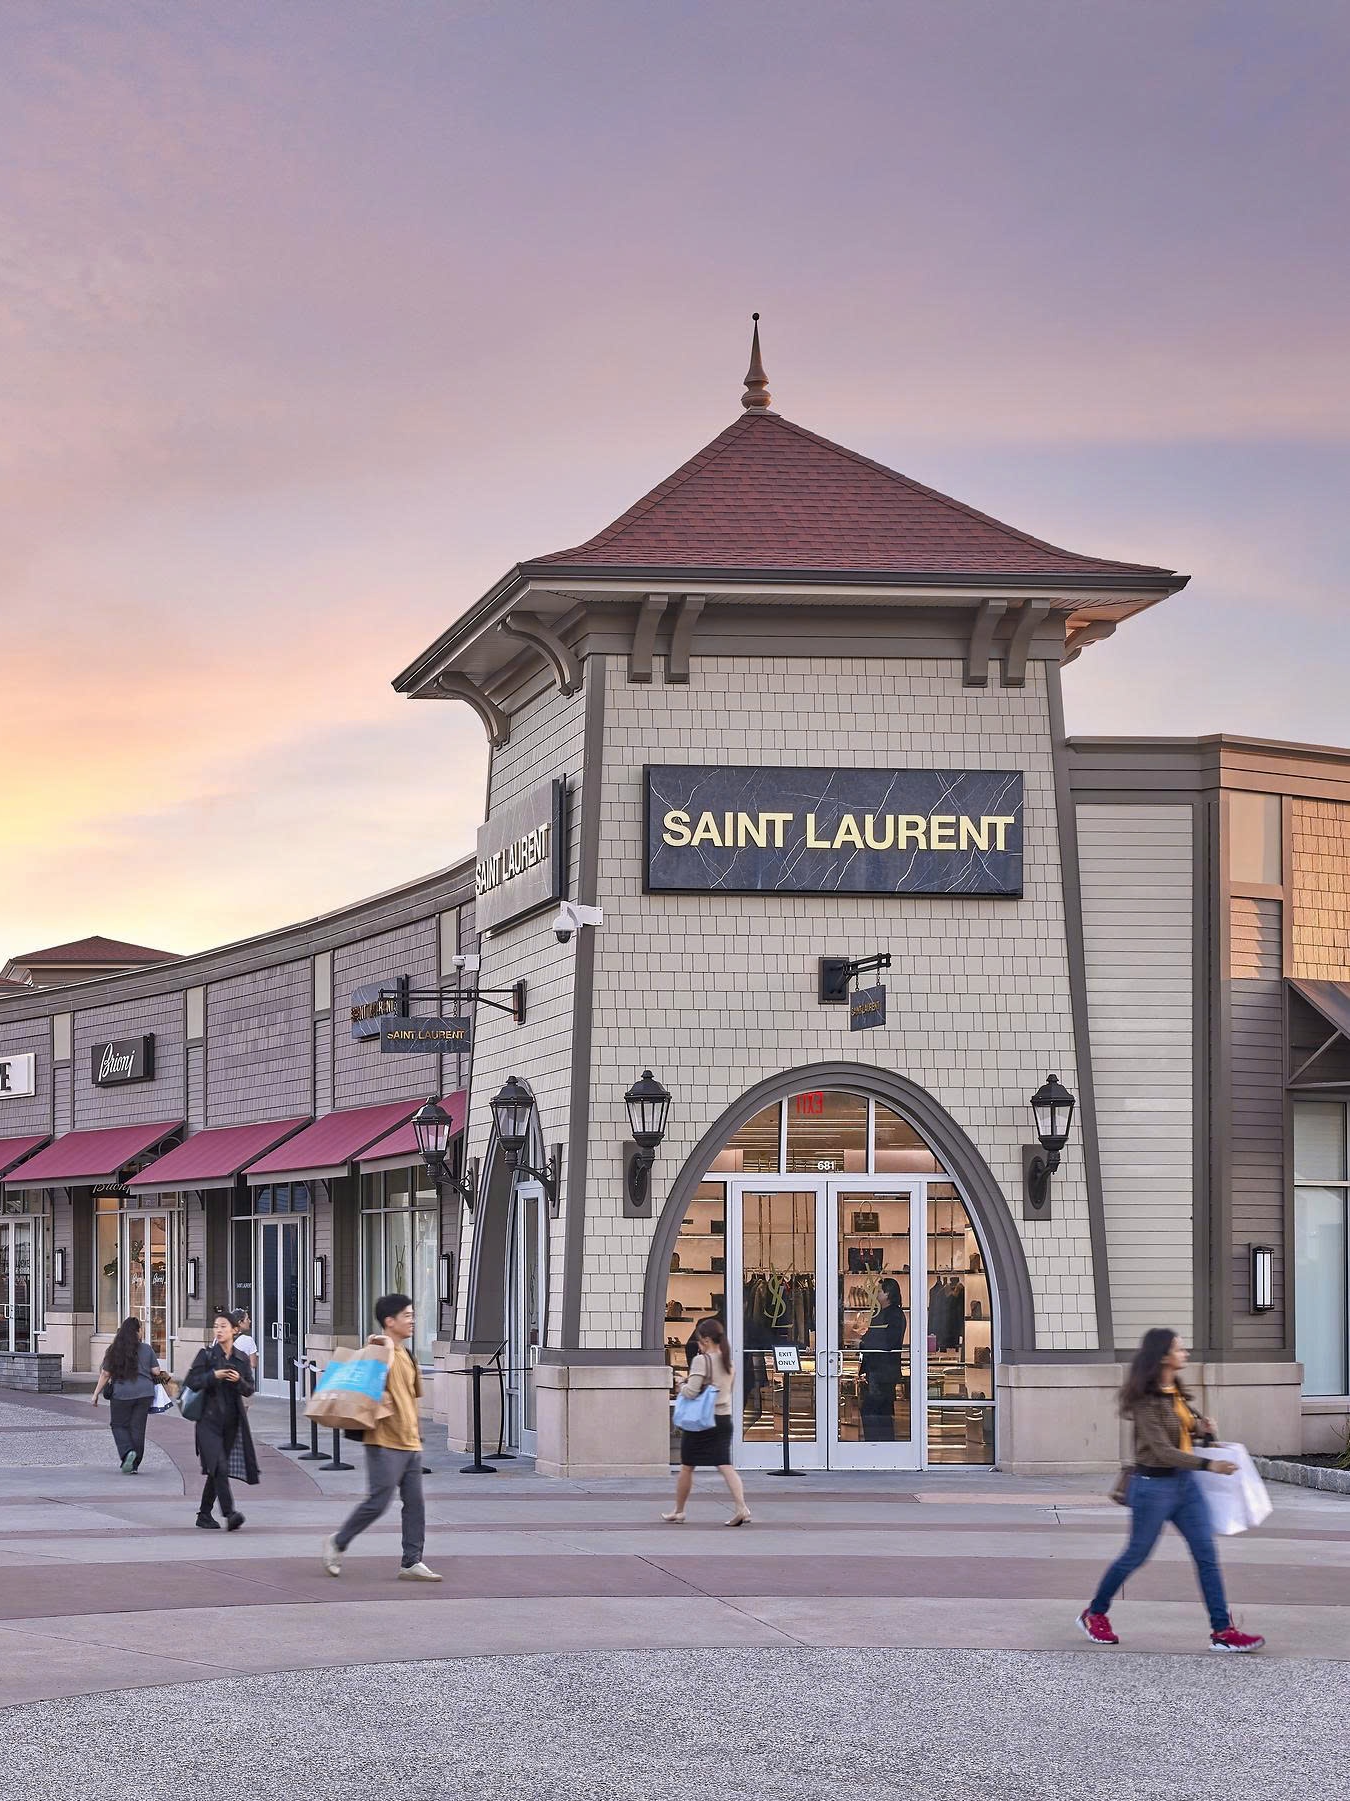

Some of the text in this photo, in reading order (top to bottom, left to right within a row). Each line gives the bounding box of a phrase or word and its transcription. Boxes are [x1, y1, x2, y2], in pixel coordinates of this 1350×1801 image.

[662, 809, 1015, 851] SAINT LAURENT
[475, 822, 550, 895] SAINT LAURENT
[387, 1030, 465, 1040] SAINT LAURENT
[98, 1042, 135, 1082] Brioni
[817, 1160, 835, 1171] 681
